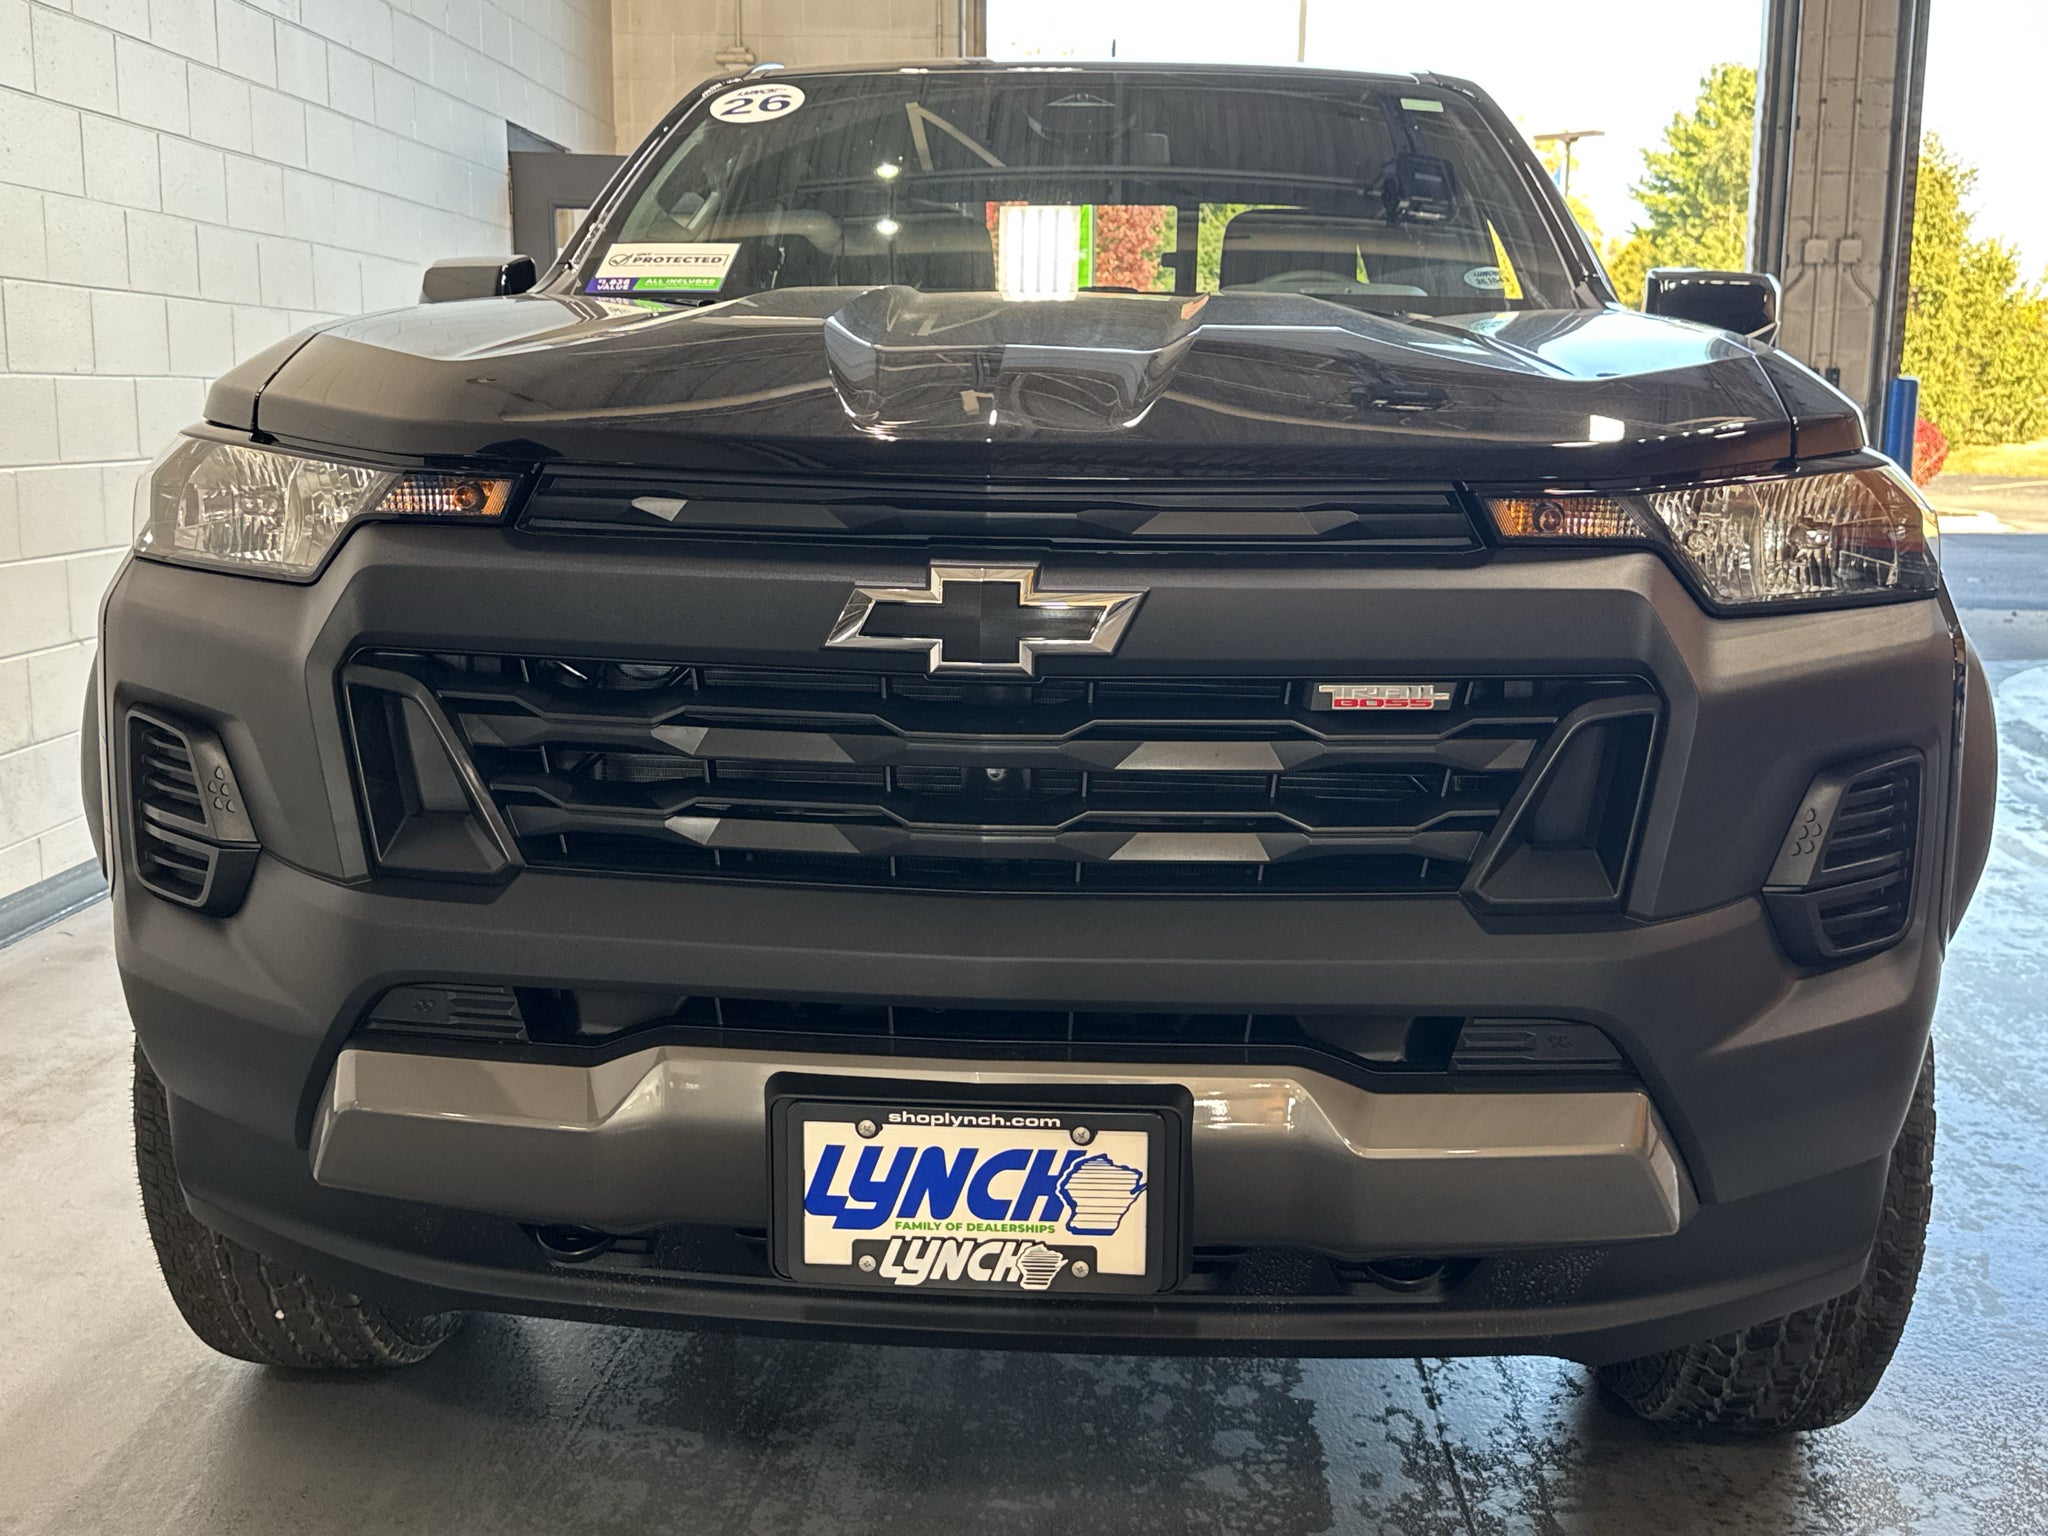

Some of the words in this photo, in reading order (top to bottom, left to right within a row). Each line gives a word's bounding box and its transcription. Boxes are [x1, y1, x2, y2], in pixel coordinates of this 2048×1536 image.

[720, 95, 792, 116] 26
[632, 256, 722, 264] PROTECTED
[1319, 685, 1450, 700] TRAIL
[1332, 698, 1434, 709] BOSS
[888, 1111, 1061, 1127] shoplynch.com
[804, 1144, 1088, 1230] LYNCH
[895, 1221, 942, 1231] FAMILY
[945, 1222, 964, 1231] OF
[966, 1222, 1056, 1233] DEALERSHIPS
[879, 1238, 1033, 1286] LYNCH
